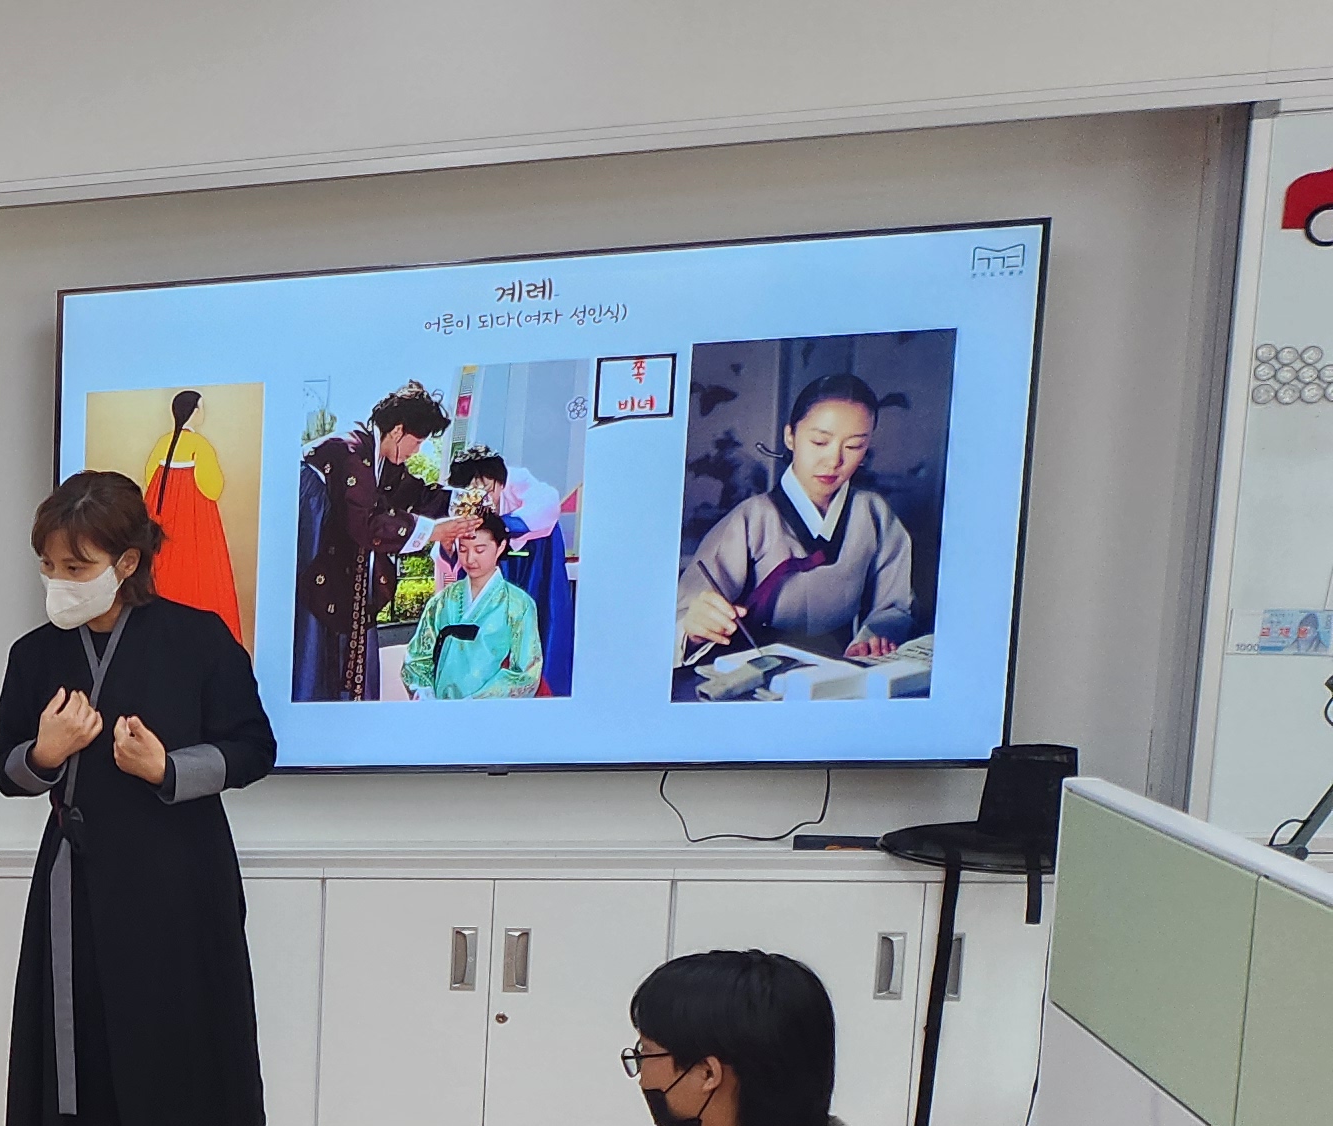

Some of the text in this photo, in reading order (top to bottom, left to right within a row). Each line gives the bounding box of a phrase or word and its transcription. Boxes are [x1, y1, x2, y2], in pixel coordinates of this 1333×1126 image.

[424, 314, 470, 334] 어른이
[570, 304, 627, 325] 성인식)
[618, 397, 655, 411] 비녀
